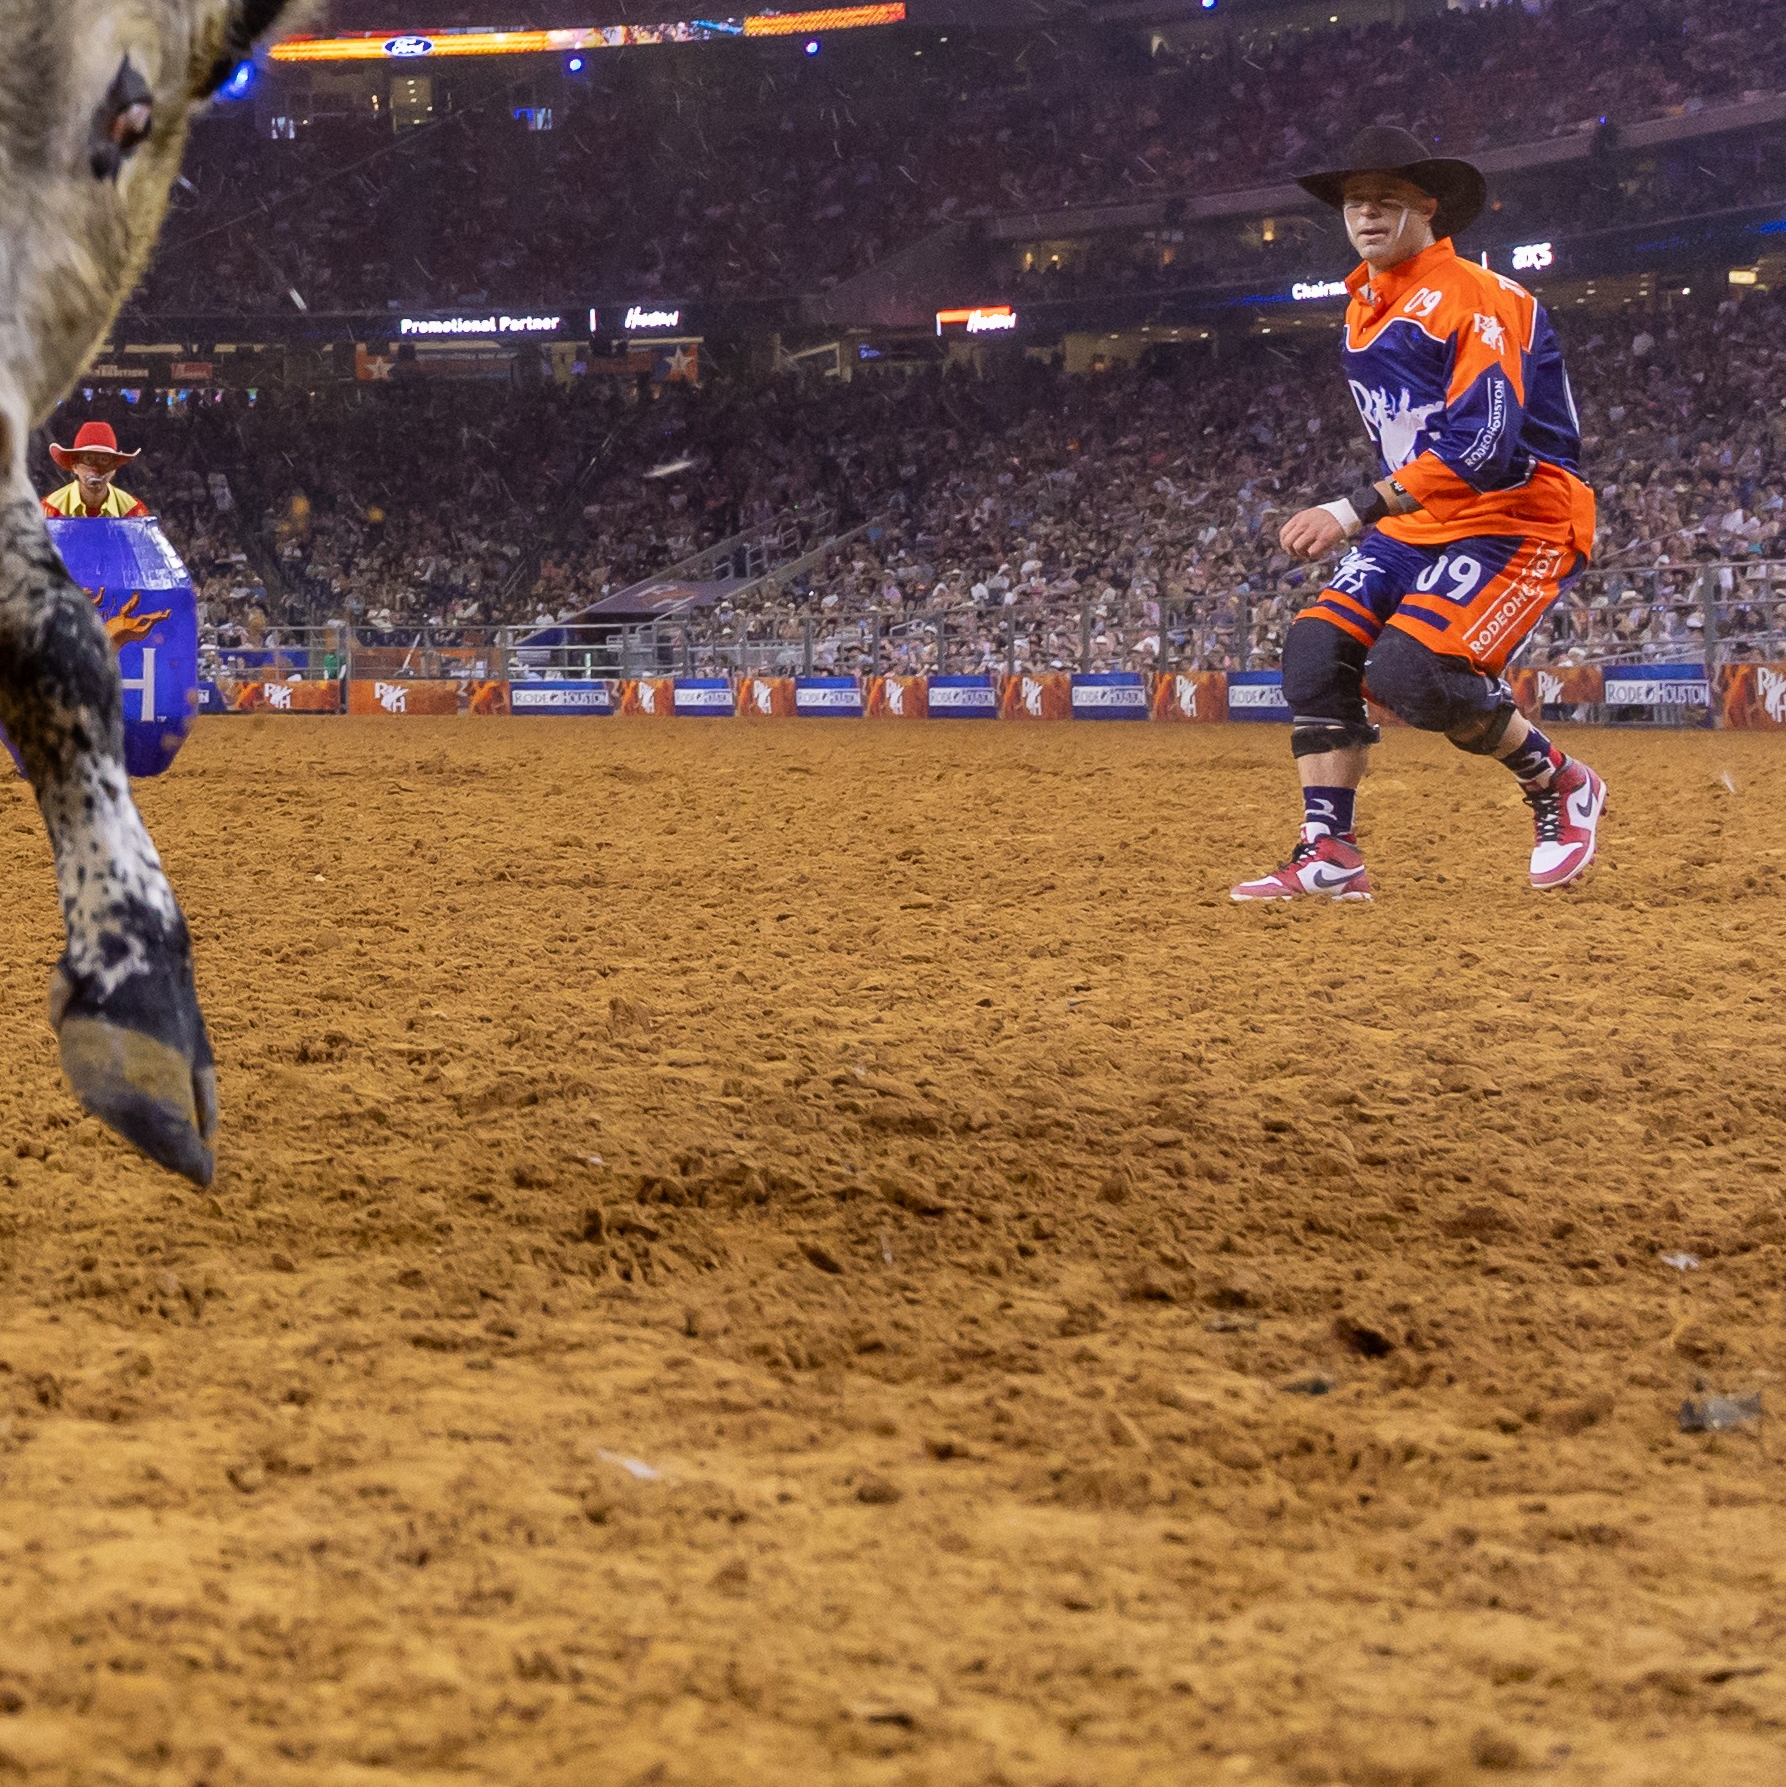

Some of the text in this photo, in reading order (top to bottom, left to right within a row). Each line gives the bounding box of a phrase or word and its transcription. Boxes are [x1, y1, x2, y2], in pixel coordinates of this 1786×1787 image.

[1291, 281, 1347, 300] Chairm
[1403, 287, 1442, 316] 09
[400, 313, 561, 334] Promotional Partner
[1416, 554, 1481, 601] 09
[514, 690, 561, 704] RODEO
[1608, 681, 1708, 704] RODEO HOUSTON
